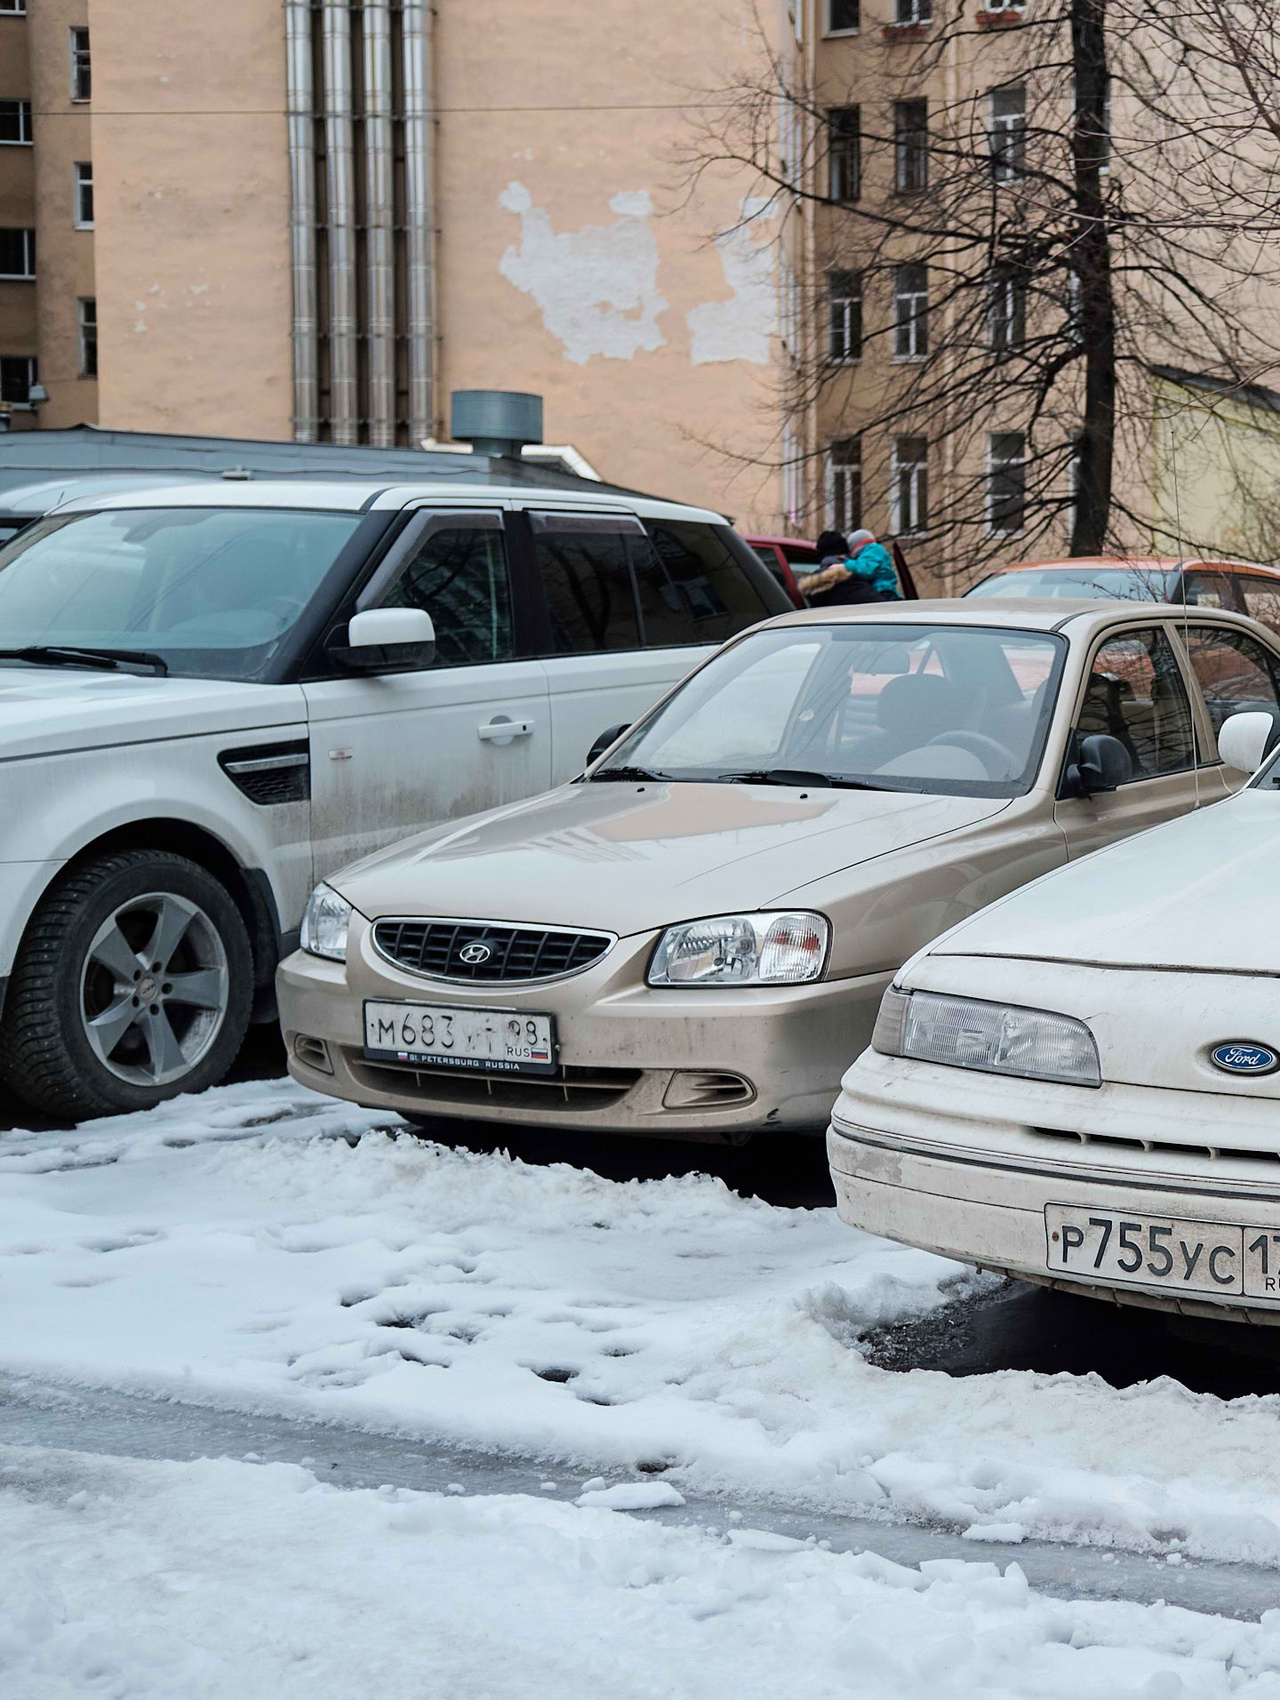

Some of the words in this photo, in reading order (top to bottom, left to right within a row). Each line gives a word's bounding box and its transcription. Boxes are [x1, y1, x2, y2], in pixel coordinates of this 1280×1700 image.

[508, 1019, 538, 1046] 98
[506, 1046, 530, 1058] RUS
[1225, 1047, 1261, 1065] Ford
[422, 1055, 480, 1067] PETERSBURG
[485, 1061, 520, 1070] RUSSIA
